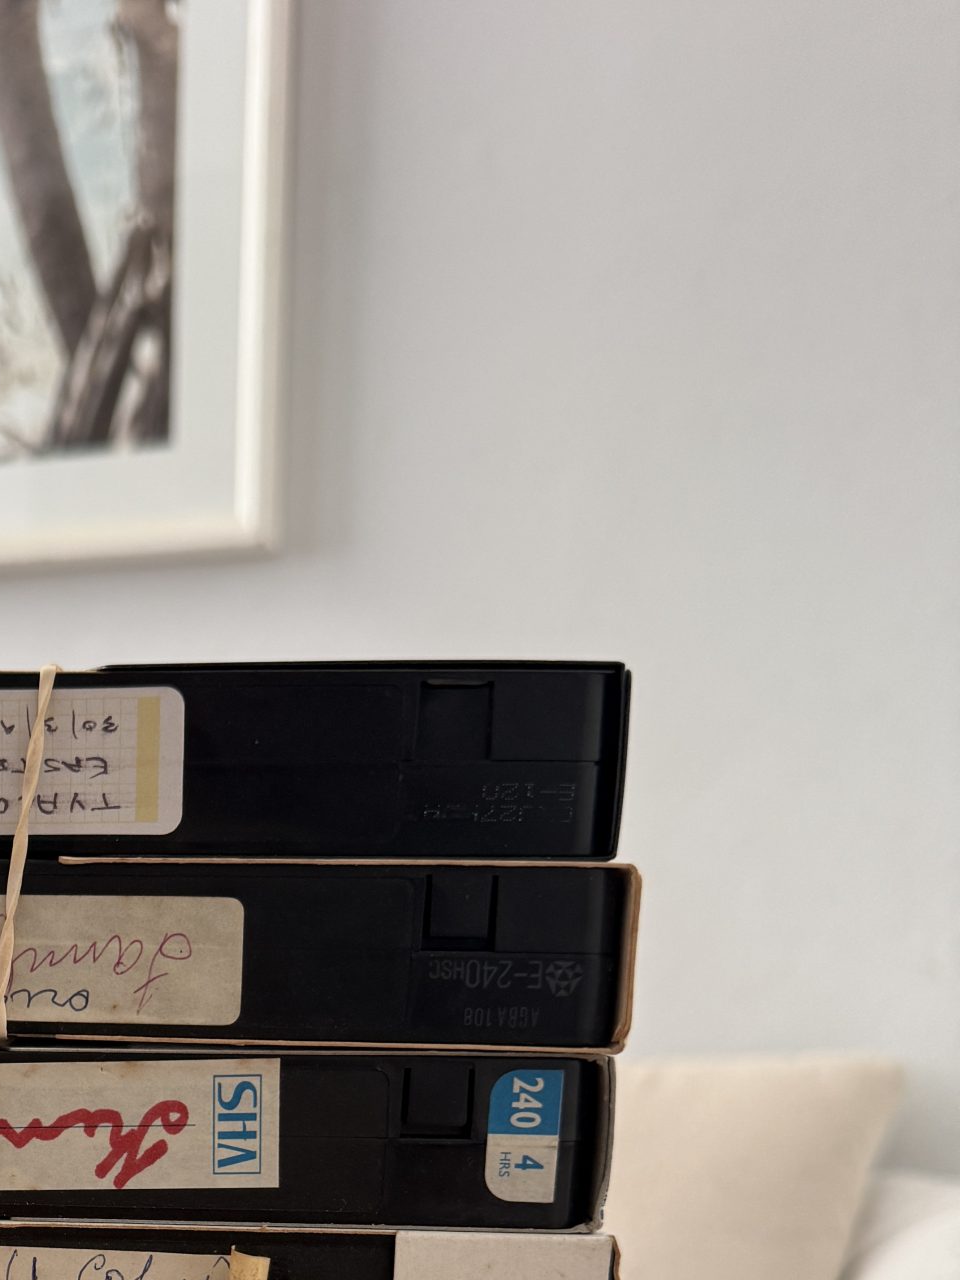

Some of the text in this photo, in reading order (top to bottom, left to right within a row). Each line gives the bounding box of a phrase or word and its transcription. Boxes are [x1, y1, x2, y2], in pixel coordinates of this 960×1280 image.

[509, 1077, 545, 1129] 240
[217, 1081, 258, 1168] VHS
[498, 1152, 512, 1178] HRS
[513, 1154, 545, 1171] 4
